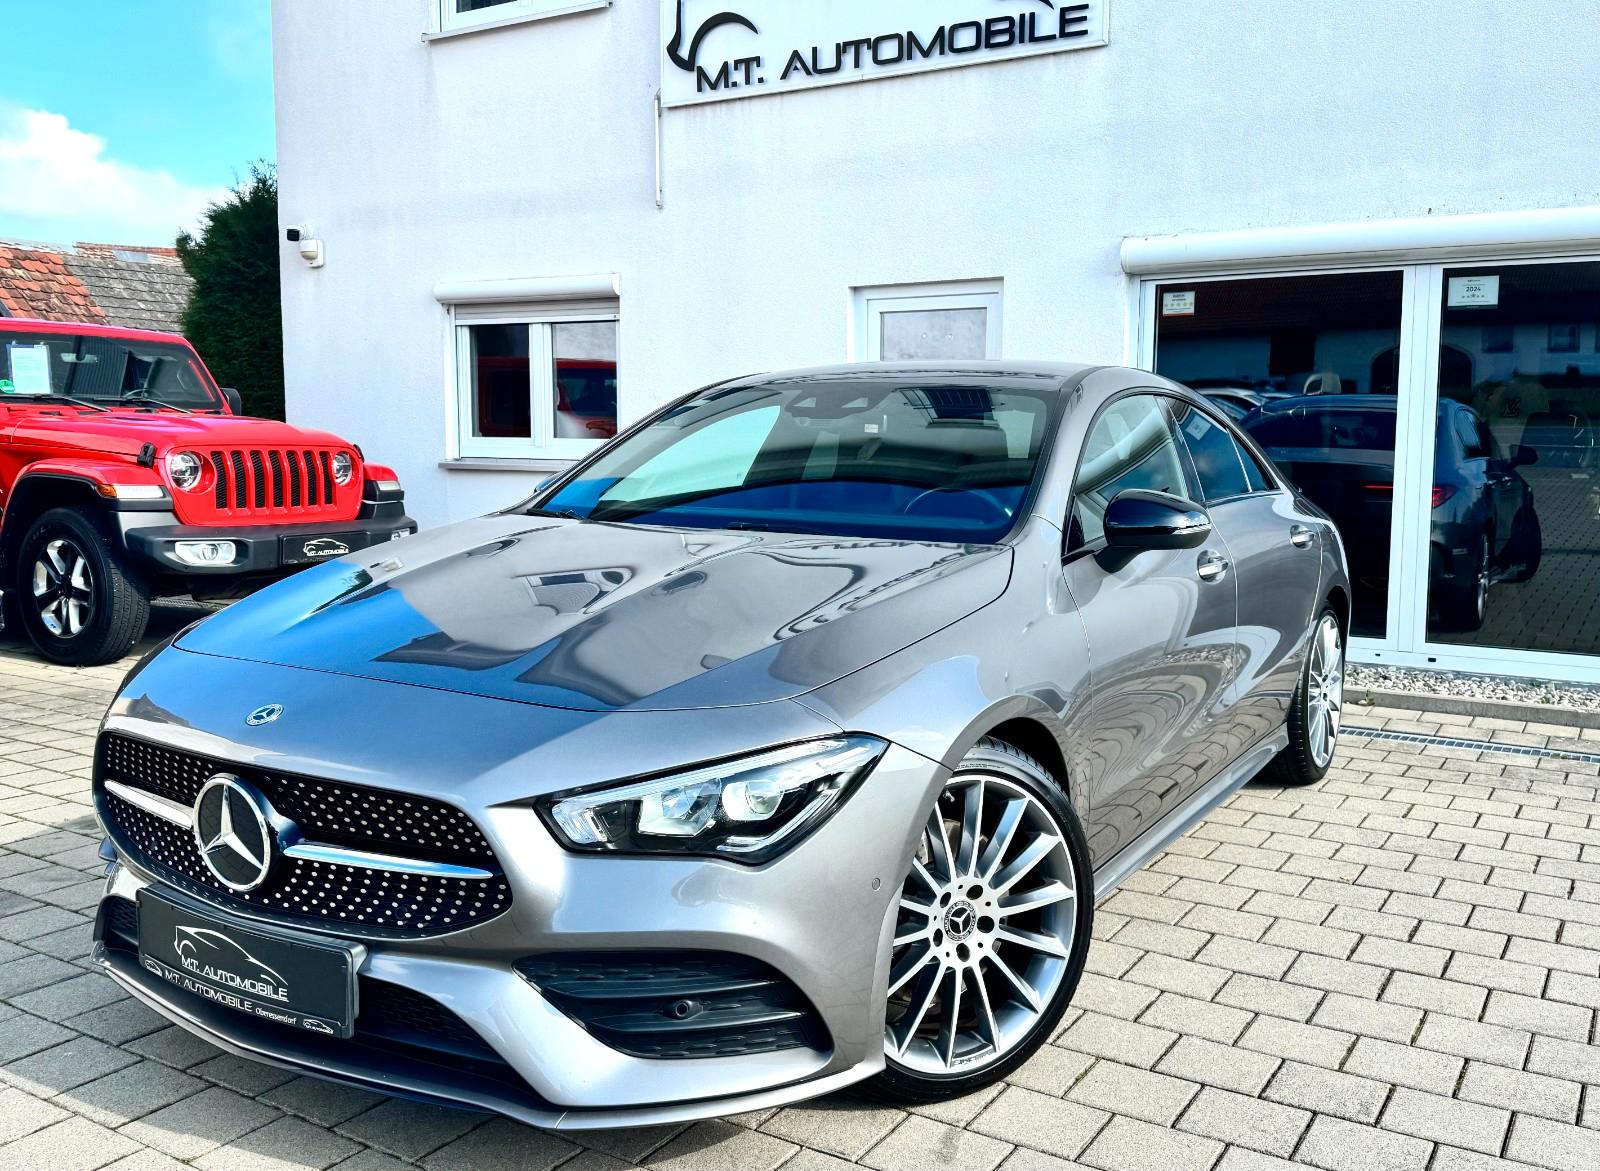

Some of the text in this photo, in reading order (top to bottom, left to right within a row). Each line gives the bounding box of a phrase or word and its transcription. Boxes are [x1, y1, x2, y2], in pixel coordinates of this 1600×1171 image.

[696, 4, 1089, 92] M.T. AUTOMOBILE
[165, 969, 181, 985] M.T.
[183, 979, 253, 1012] AUTOMOBILE
[181, 954, 288, 999] M.T. AUTOMOBILE
